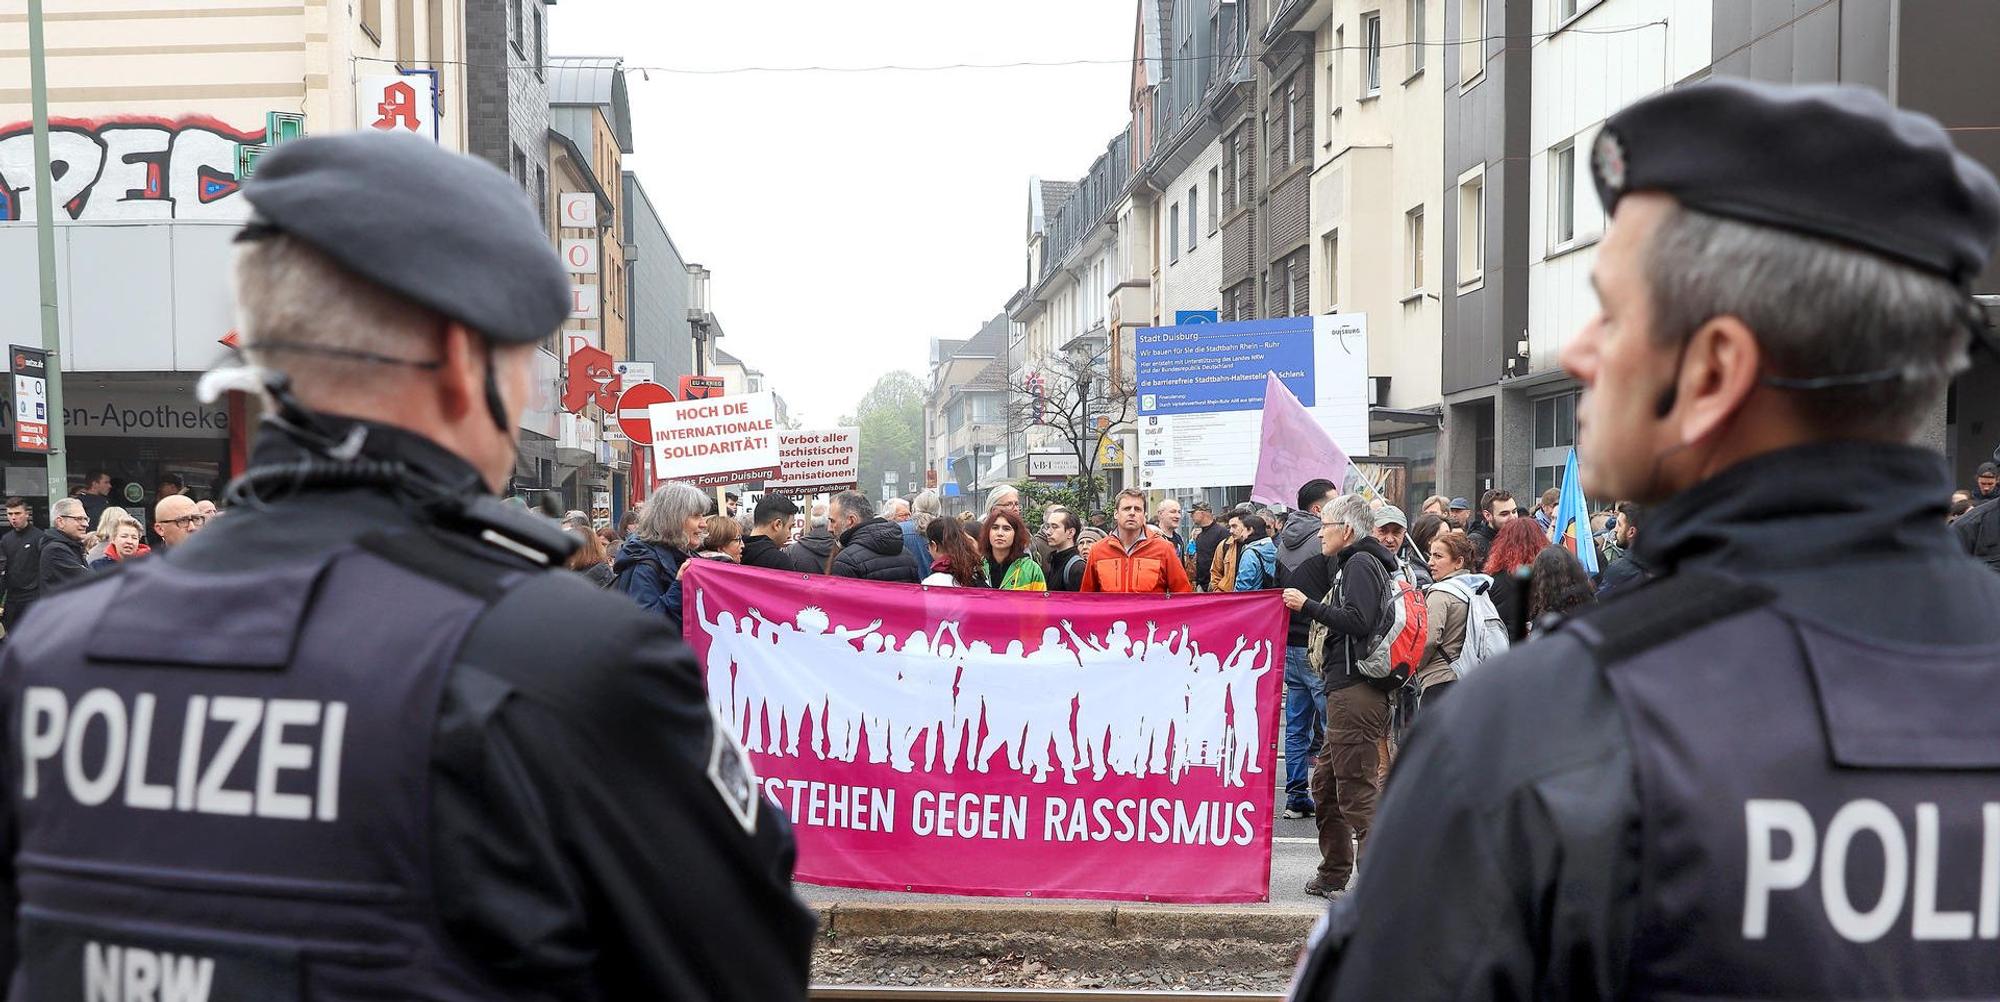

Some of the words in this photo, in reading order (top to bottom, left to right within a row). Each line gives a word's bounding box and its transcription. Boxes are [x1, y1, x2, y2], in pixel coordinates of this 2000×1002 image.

[1140, 334, 1160, 343] Stadt
[1162, 332, 1199, 342] Duisburg
[1140, 349, 1152, 357] Wir
[1153, 348, 1172, 356] bauen
[1173, 347, 1183, 355] für
[1184, 346, 1194, 354] Sie
[1194, 345, 1205, 353] die
[1206, 343, 1239, 352] Stadtbahn
[1239, 342, 1258, 350] Rhein
[1264, 341, 1280, 349] Ruhr
[1161, 364, 1201, 373] Bundesrepublik
[1184, 357, 1221, 365] Unterstützung
[1152, 377, 1194, 386] barrierefreie
[1194, 372, 1267, 384] Stadtbahn-Haltestelle
[1278, 369, 1305, 379] Schlenk
[62, 402, 228, 433] en-Apotheke
[676, 406, 719, 421] HOCH
[723, 402, 749, 416] DIE
[656, 419, 773, 441] INTERNATIONALE
[780, 434, 820, 445] Verbot
[822, 433, 848, 443] aller
[664, 437, 768, 460] SOLIDARITÄT!
[779, 445, 853, 458] aschistischen
[781, 458, 824, 469] arteien
[828, 456, 849, 466] und
[698, 474, 729, 485] Forum
[731, 470, 774, 482] Duisburg
[782, 468, 856, 483] ganisationen!
[772, 487, 794, 495] Freies
[795, 486, 818, 494] Forum
[22, 686, 348, 822] POLIZEI
[753, 775, 896, 833] STEHEN
[911, 789, 1028, 840] GEGEN
[1043, 796, 1256, 847] RASSISMUS
[83, 941, 215, 1002] NRW
